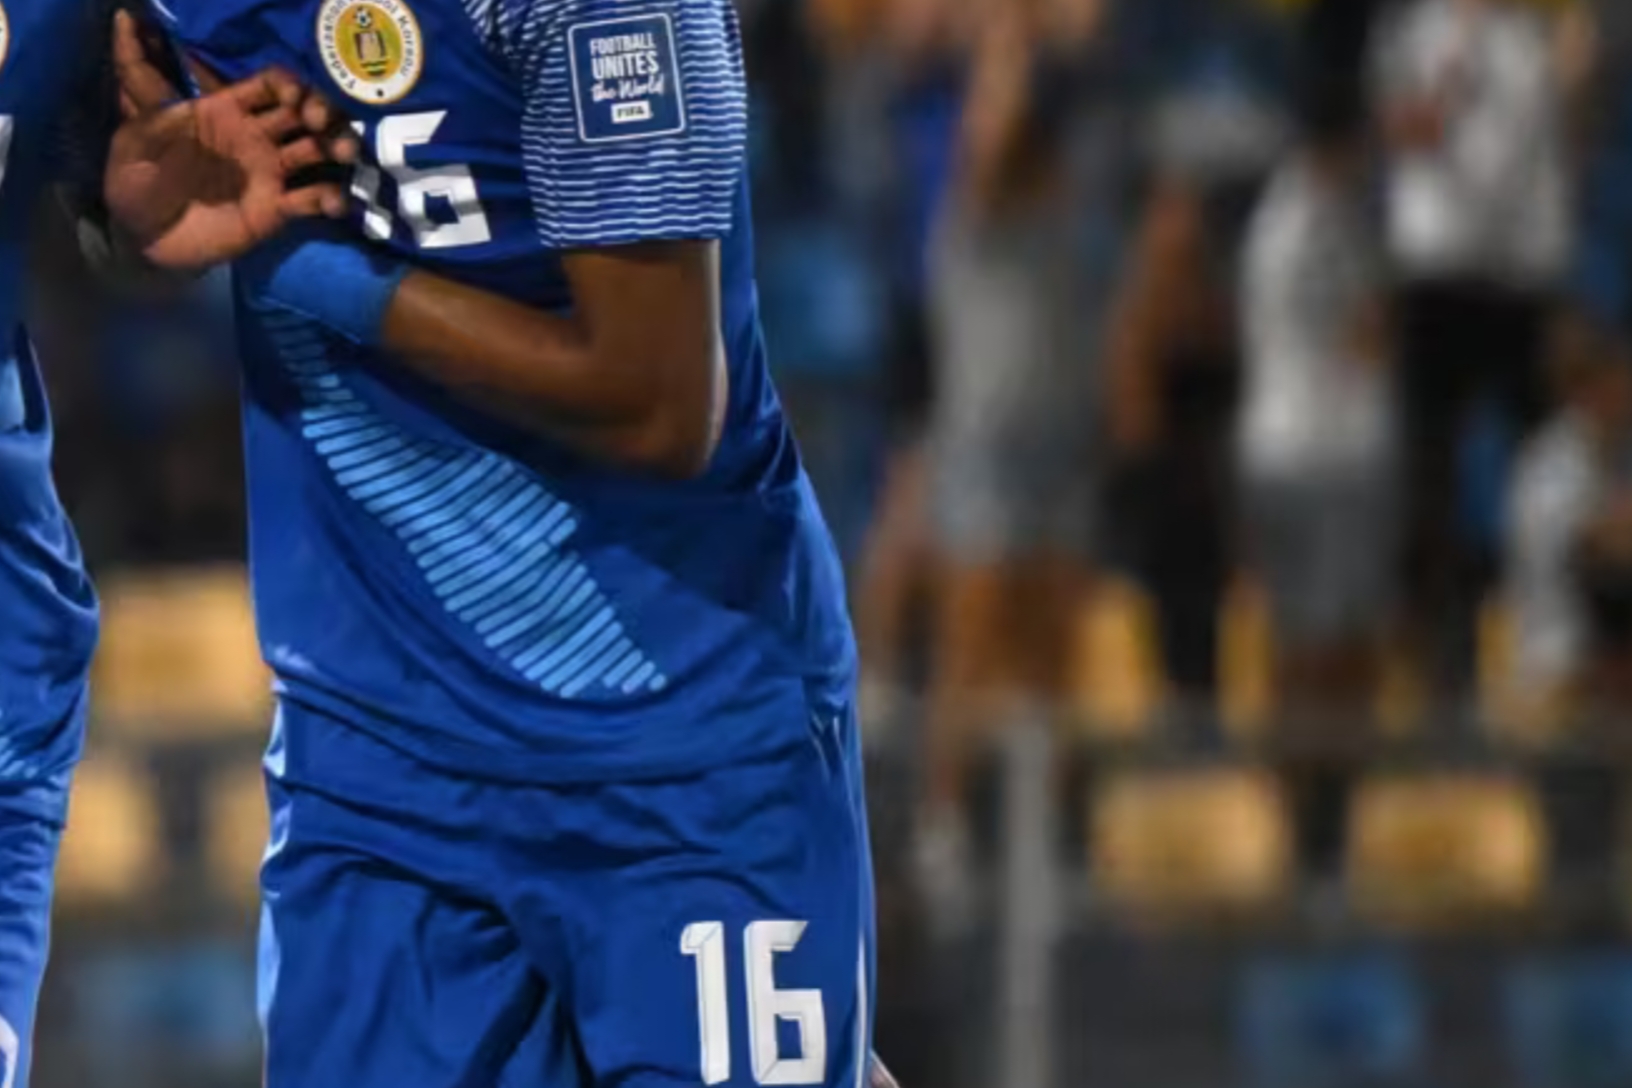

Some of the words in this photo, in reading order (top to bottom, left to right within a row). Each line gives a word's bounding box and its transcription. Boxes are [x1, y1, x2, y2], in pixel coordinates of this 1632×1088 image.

[590, 32, 656, 57] FOOTBALL
[592, 50, 659, 80] UNITES
[590, 80, 617, 103] the
[618, 73, 664, 99] World
[616, 105, 645, 120] FIFA
[680, 920, 827, 1087] 16
